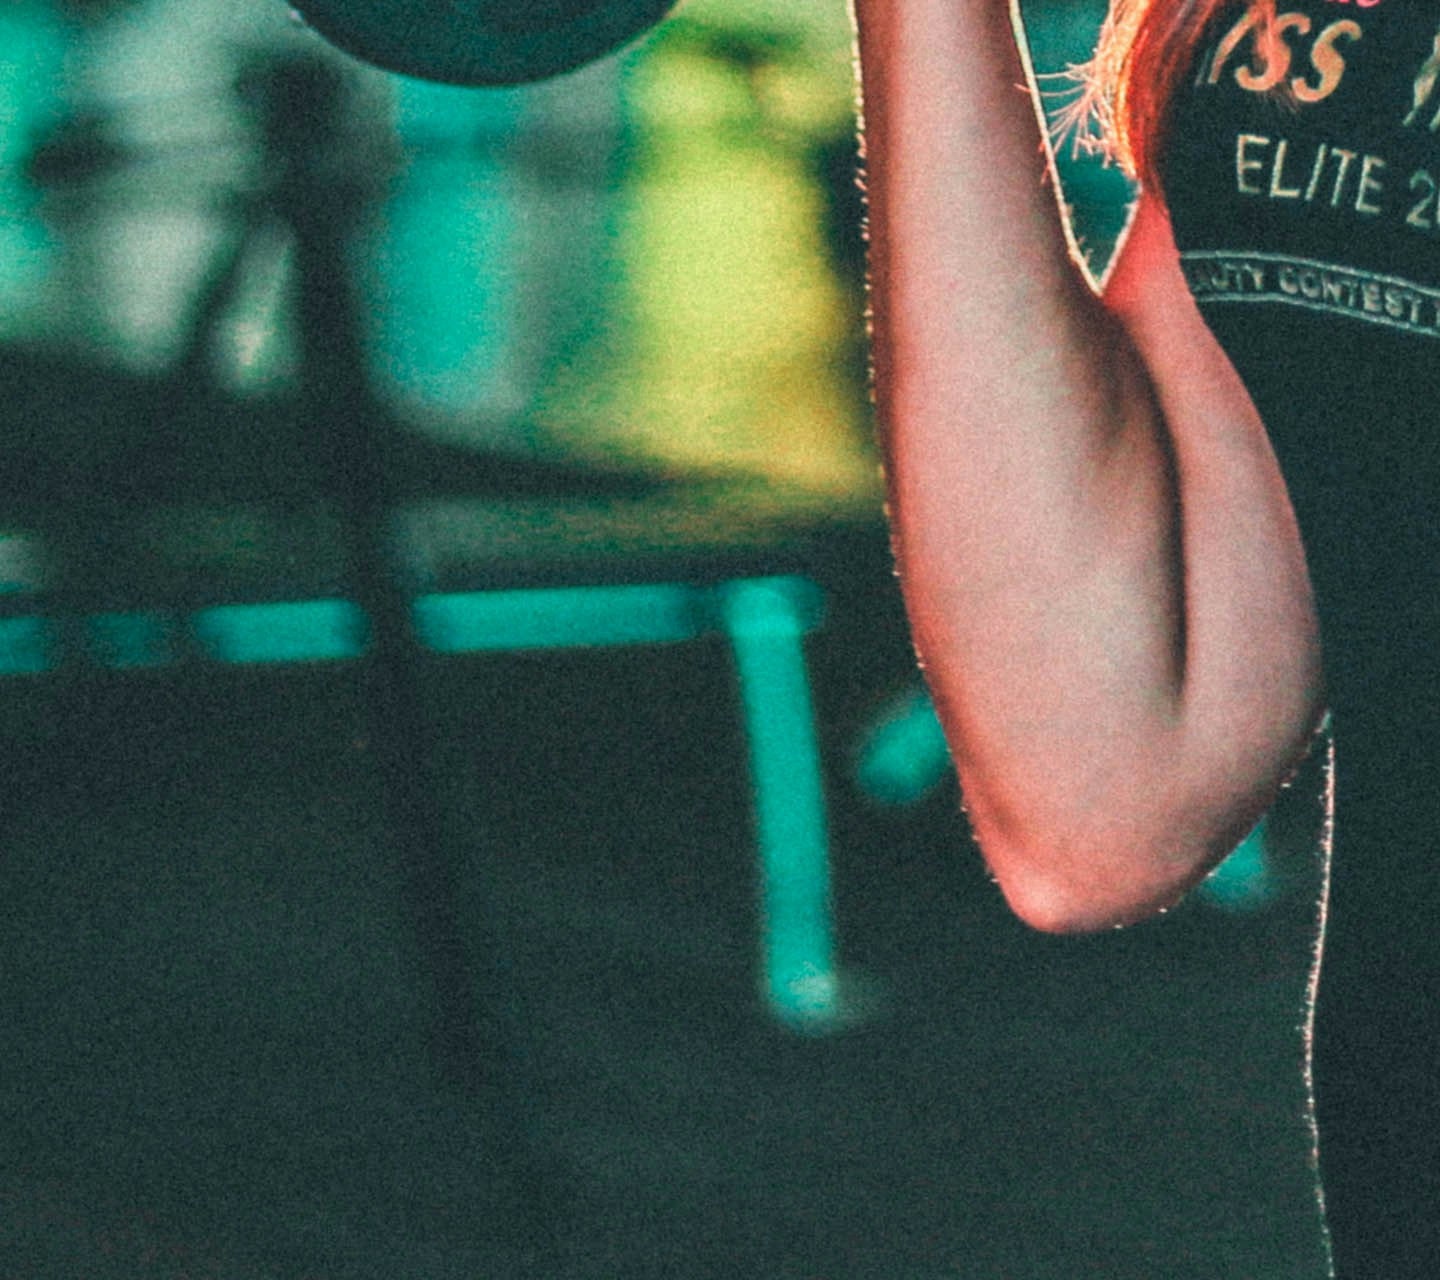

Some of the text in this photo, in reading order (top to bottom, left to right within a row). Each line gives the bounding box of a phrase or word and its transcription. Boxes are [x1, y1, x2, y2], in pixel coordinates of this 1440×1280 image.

[1194, 12, 1362, 103] ISS
[1236, 134, 1387, 214] ELITE
[1278, 264, 1422, 325] CONTEST
